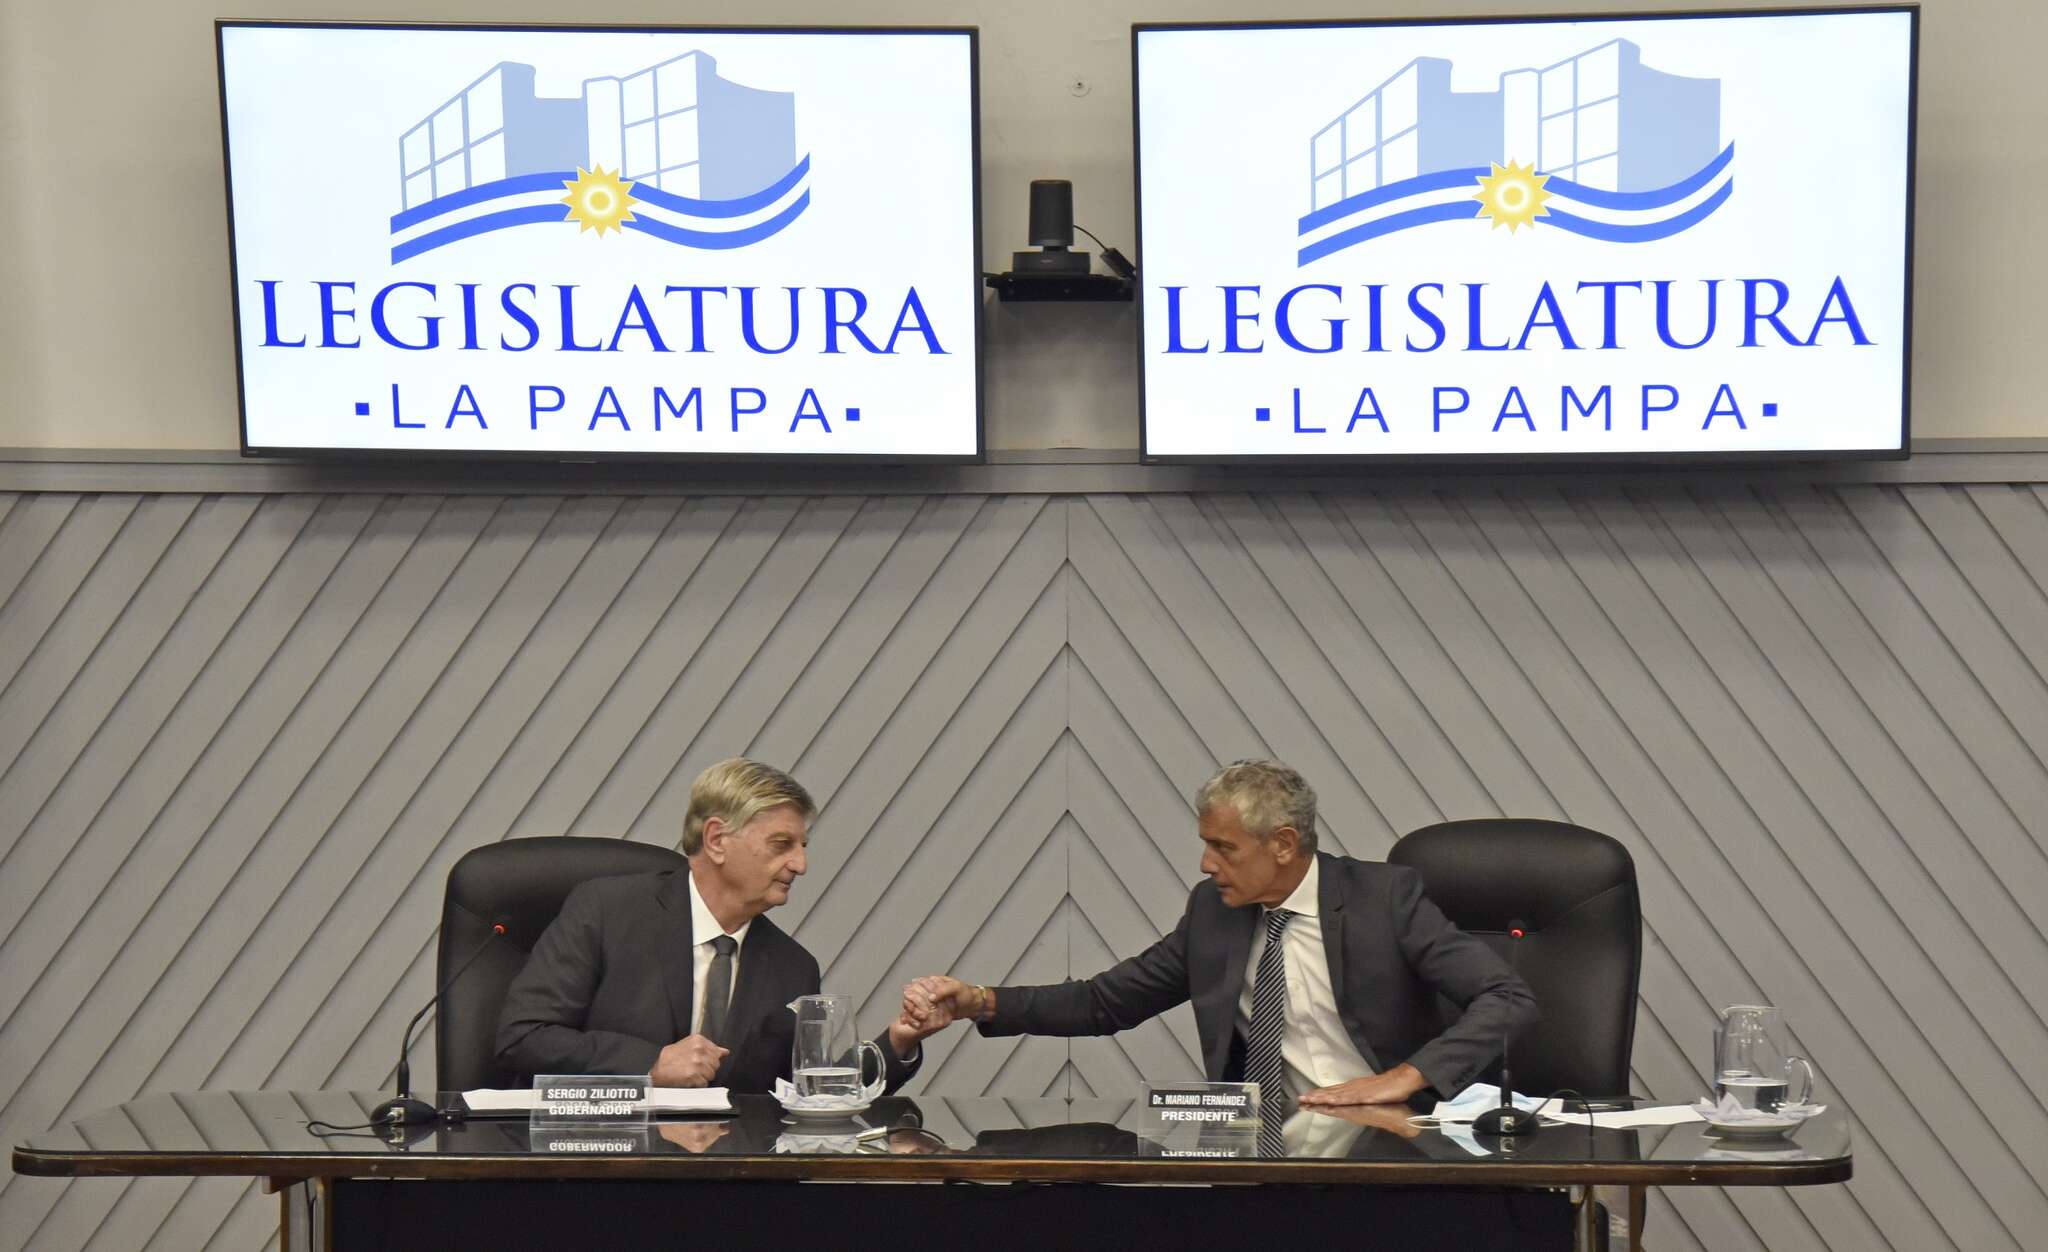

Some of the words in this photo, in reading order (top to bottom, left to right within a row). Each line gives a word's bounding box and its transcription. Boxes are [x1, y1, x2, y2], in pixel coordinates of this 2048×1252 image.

[255, 280, 951, 355] LEGISLATURA
[1160, 275, 1878, 354] LEGISLATURA
[391, 384, 488, 430] LA
[528, 385, 832, 433] PAMPA
[1293, 387, 1390, 434] LA
[1432, 384, 1746, 433] PAMPA
[547, 1088, 587, 1099] SERGIO
[590, 1088, 637, 1099] ZILIOTTO
[1152, 1094, 1163, 1105] Dr.
[1165, 1094, 1200, 1105] MARIANO
[1202, 1093, 1246, 1106] FERNÁNDEZ
[549, 1104, 632, 1115] GOBERNADOR
[1161, 1111, 1237, 1121] PRESIDENTE
